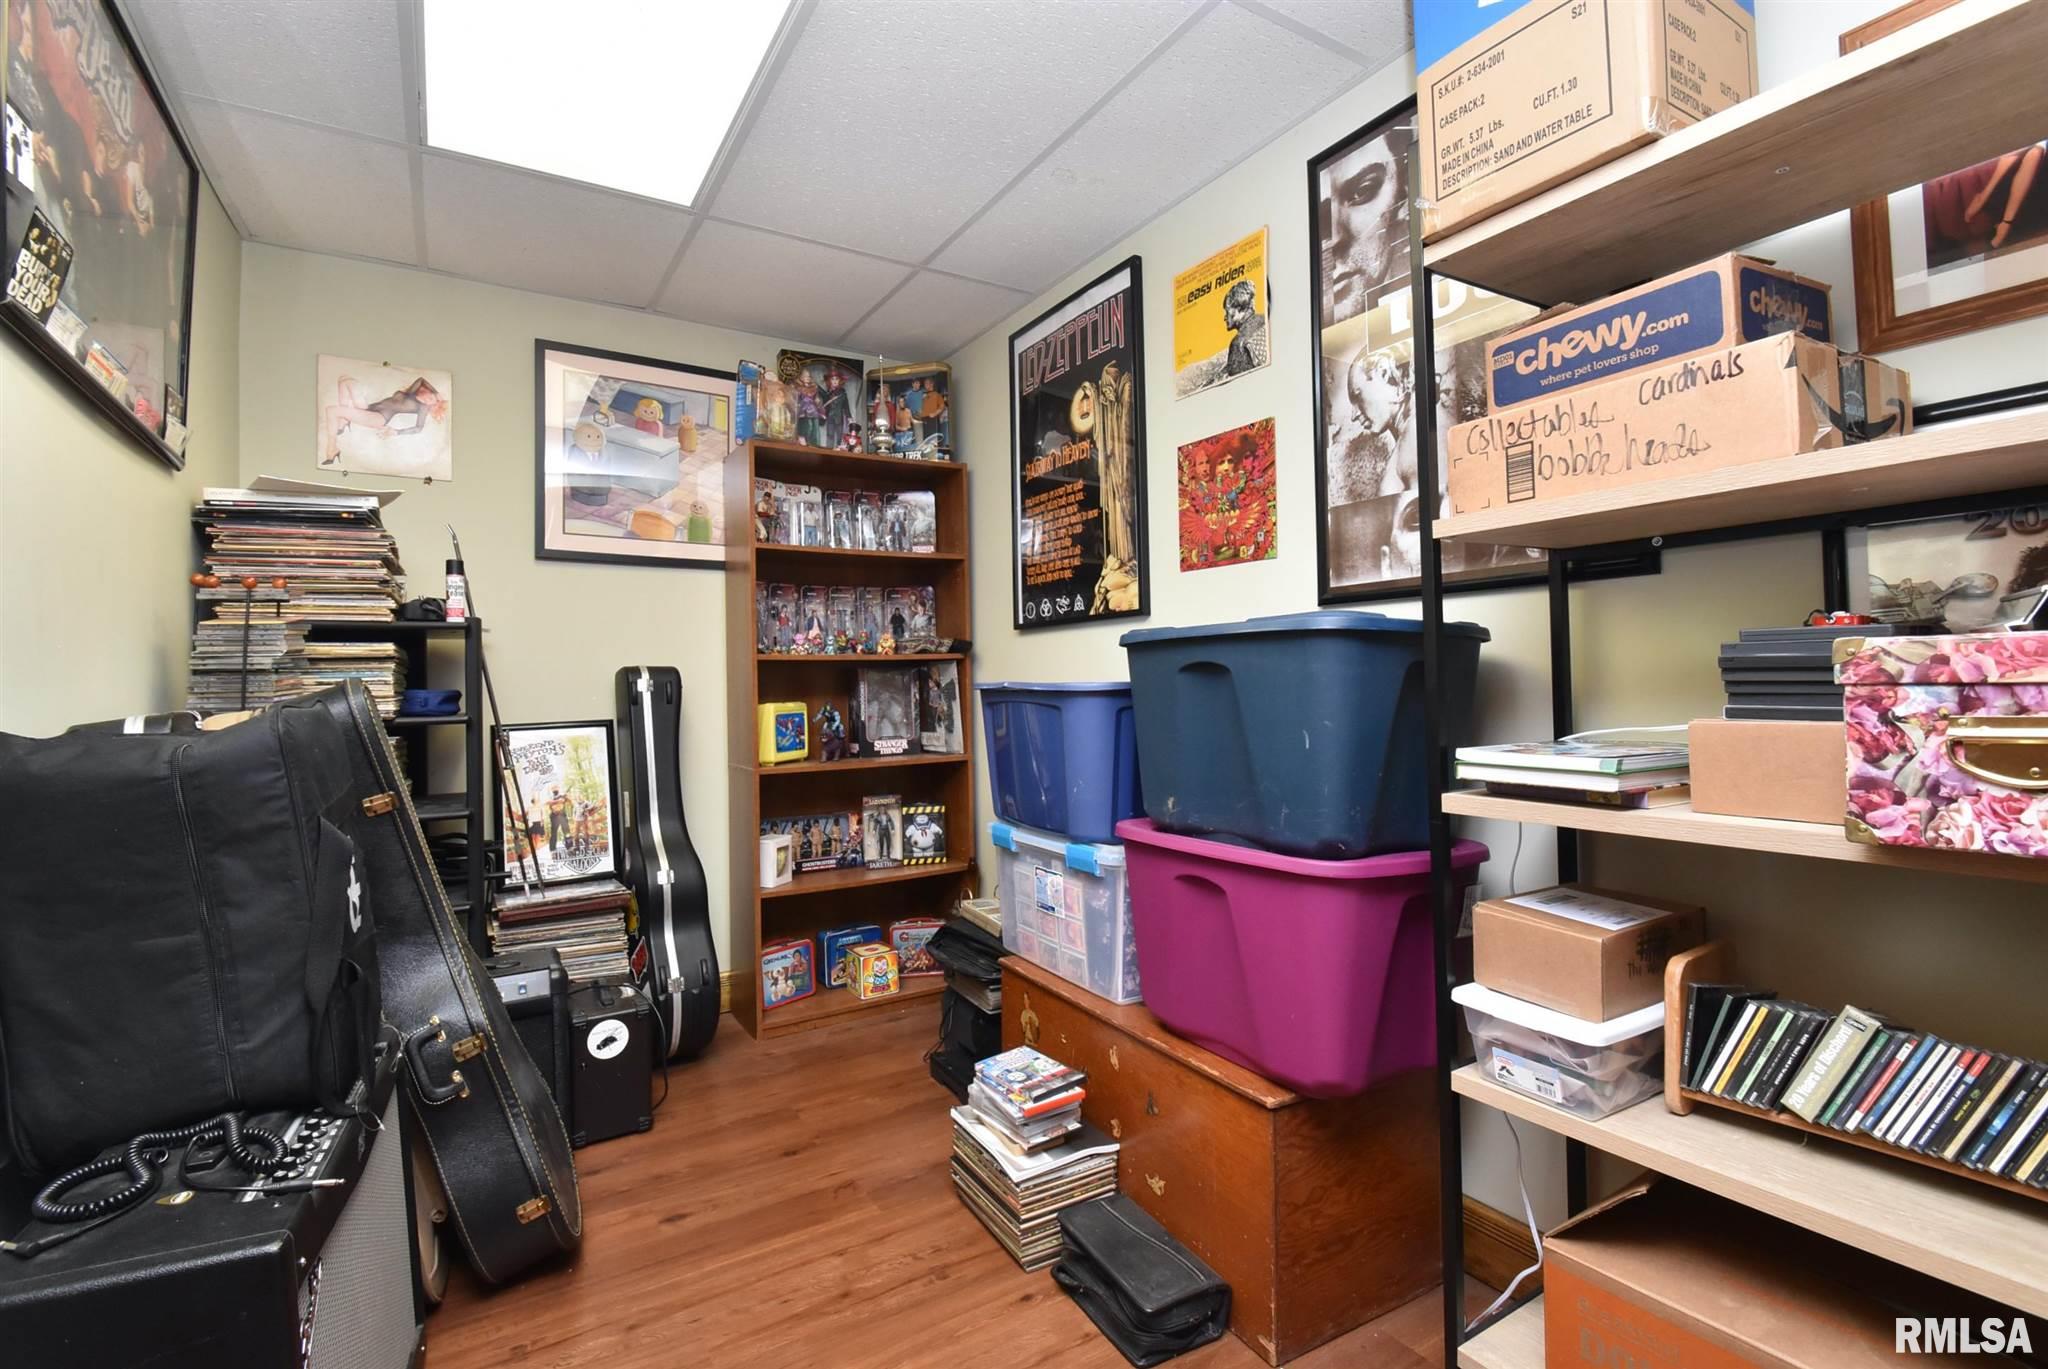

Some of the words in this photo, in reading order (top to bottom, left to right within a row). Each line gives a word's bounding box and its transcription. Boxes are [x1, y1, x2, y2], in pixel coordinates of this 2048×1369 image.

[1571, 1, 1587, 20] S21
[1467, 50, 1505, 80] 2-634-2001
[1532, 87, 1560, 110] CU.FT.
[1560, 77, 1578, 96] 1.30
[1688, 78, 1702, 96] CHINA
[1440, 108, 1459, 129] CASE
[1459, 94, 1486, 118] PACK:2
[1440, 137, 1466, 159] GR.WT.
[1469, 128, 1484, 144] 5.37
[1488, 120, 1505, 134] Lbs.
[1441, 155, 1462, 174] MADE
[1462, 151, 1470, 163] IN
[1470, 139, 1494, 160] CHINA
[1442, 157, 1493, 190] DESCRIPTION:
[1493, 143, 1515, 164] SAND
[1515, 134, 1533, 153] AND
[1533, 120, 1563, 143] WATER
[1563, 104, 1593, 128] TABLE
[6, 277, 43, 314] DEAD
[15, 262, 51, 303] YOUR
[1515, 311, 1690, 375] chewy.com
[1539, 371, 1572, 387] where
[1574, 364, 1592, 379] pet
[1593, 354, 1628, 370] lovers
[1629, 344, 1660, 360] shop
[873, 739, 909, 751] STRANGER
[880, 747, 904, 755] THINGS
[1788, 1089, 1806, 1110] 20
[1800, 1071, 1821, 1099] Years
[1817, 1021, 1854, 1066] Dischord
